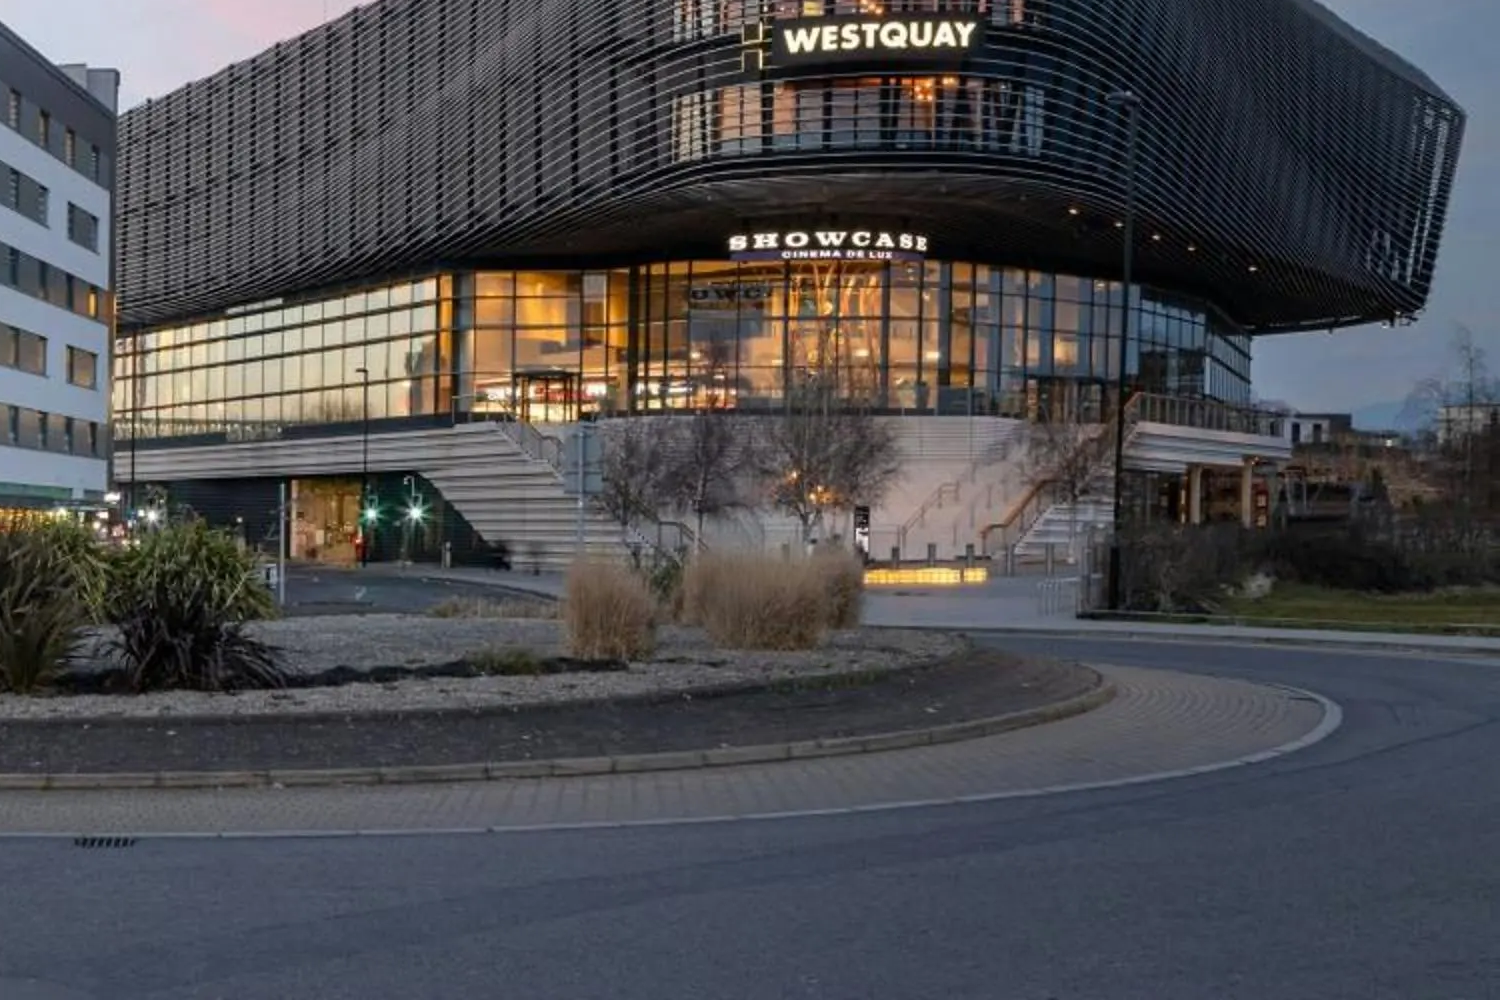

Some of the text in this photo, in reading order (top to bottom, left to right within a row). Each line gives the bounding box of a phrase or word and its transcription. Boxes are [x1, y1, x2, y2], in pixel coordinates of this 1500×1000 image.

[784, 21, 977, 53] WESTQUAY
[728, 231, 928, 251] SHOWCASE
[781, 249, 842, 259] CINEMA
[846, 249, 865, 259] DE
